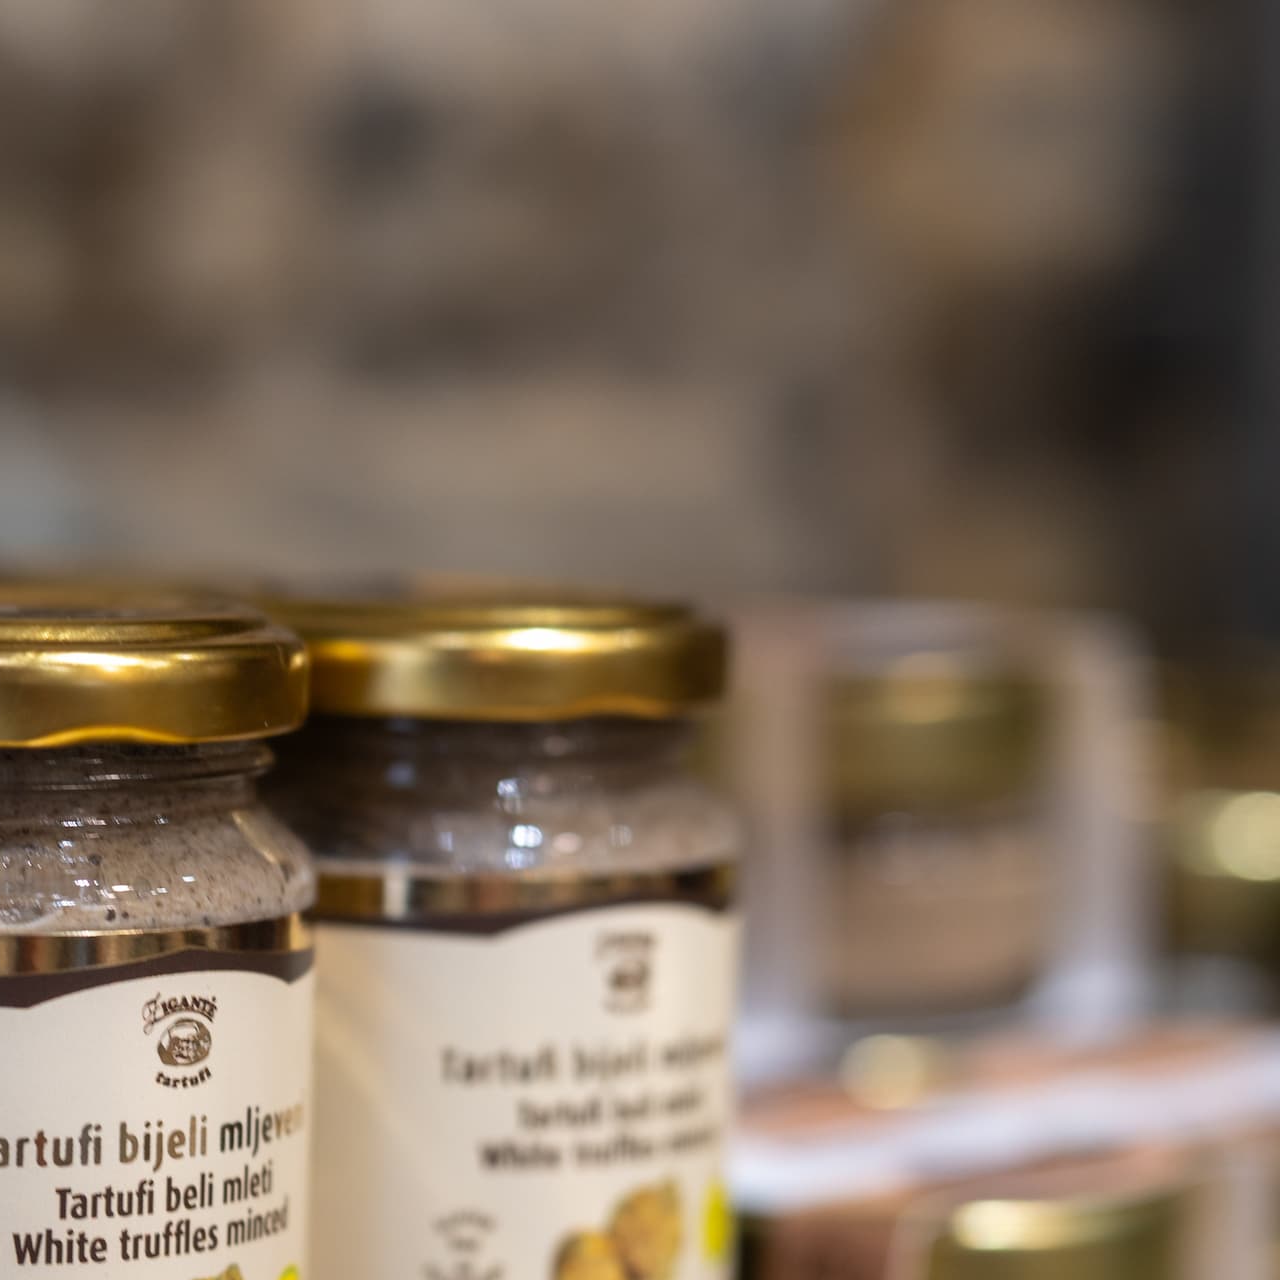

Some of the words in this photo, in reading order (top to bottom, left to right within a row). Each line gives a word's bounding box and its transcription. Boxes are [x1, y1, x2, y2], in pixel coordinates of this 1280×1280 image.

[155, 1066, 212, 1088] tartufi
[119, 1114, 208, 1173] bijeli
[55, 1179, 154, 1220] Tartufi
[166, 1171, 213, 1213] beli
[223, 1159, 272, 1205] mleti
[13, 1228, 108, 1265] White
[120, 1218, 219, 1262] truffles
[227, 1194, 289, 1247] minced
